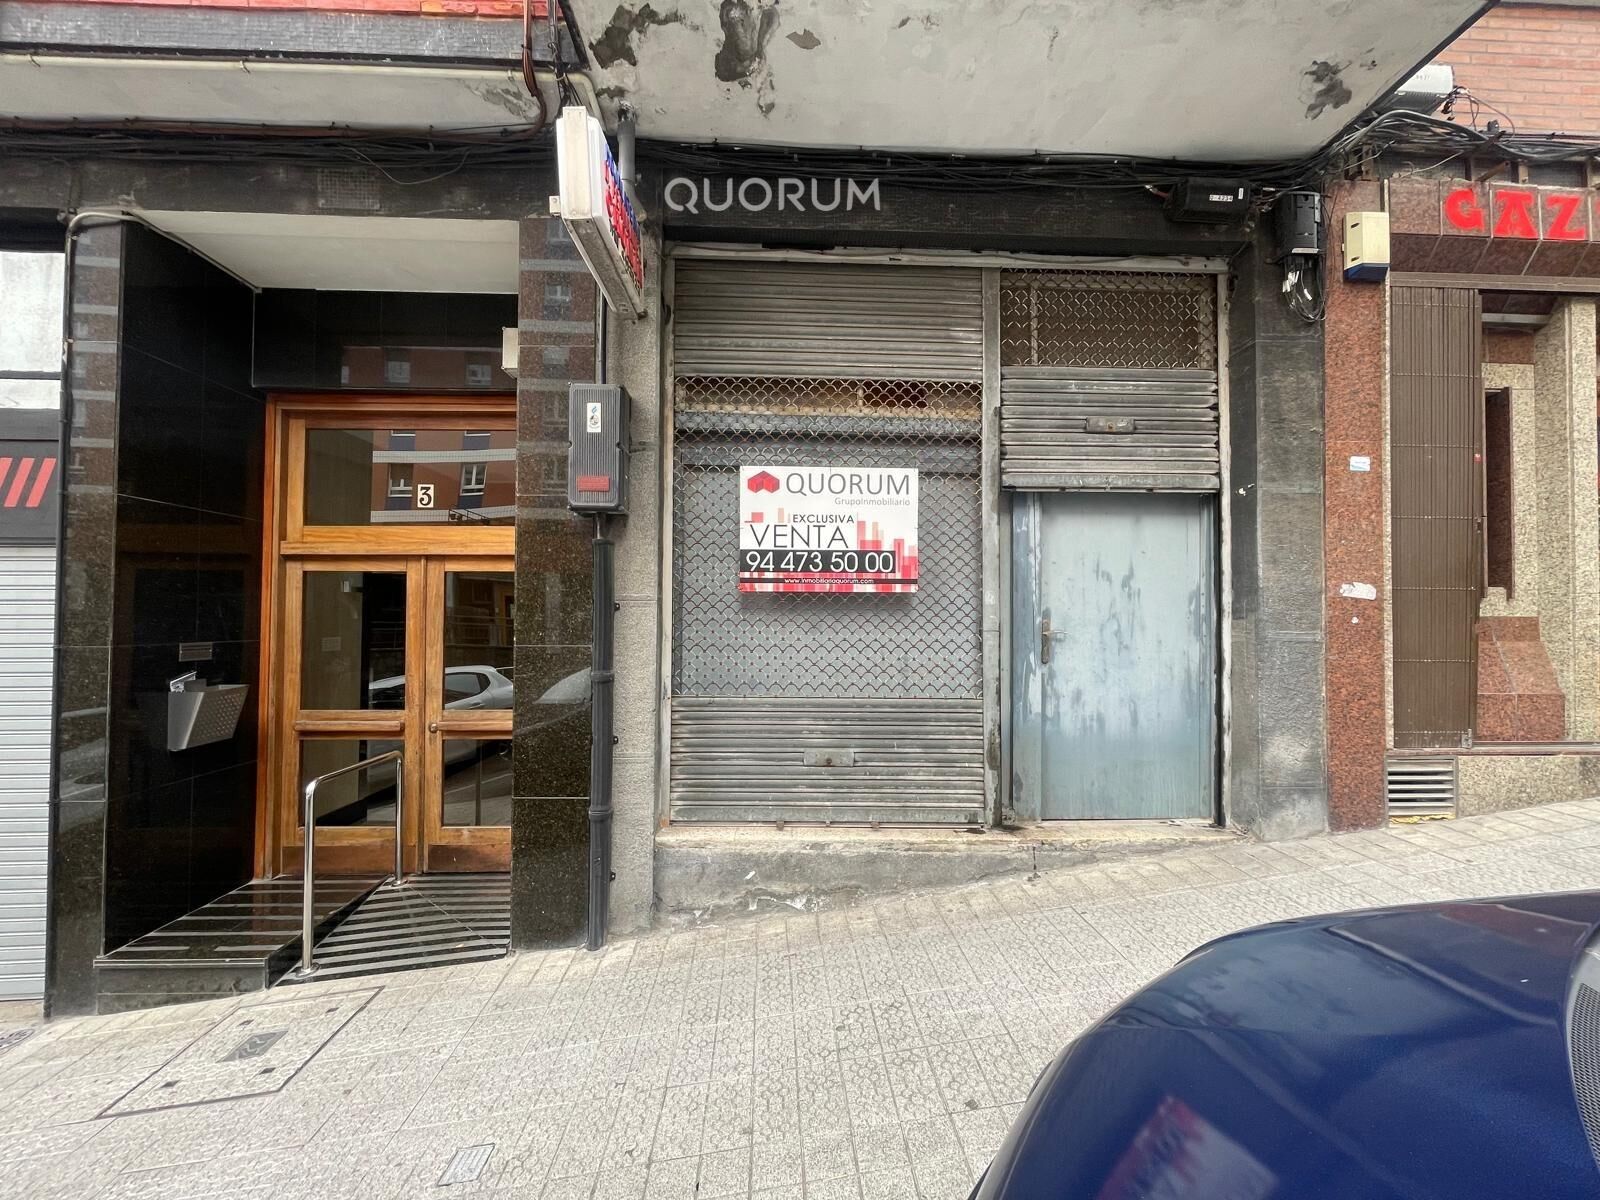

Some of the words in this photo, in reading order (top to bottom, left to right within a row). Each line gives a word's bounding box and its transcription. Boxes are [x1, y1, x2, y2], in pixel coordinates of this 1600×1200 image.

[1444, 187, 1600, 240] GAZ
[786, 472, 910, 496] QUORUM
[419, 486, 432, 506] 3
[792, 514, 854, 524] EXCLUSIVA
[750, 524, 849, 549] VENTA
[745, 551, 775, 572] 94
[780, 551, 823, 572] 473
[830, 551, 859, 573] 50
[865, 552, 893, 573] 00
